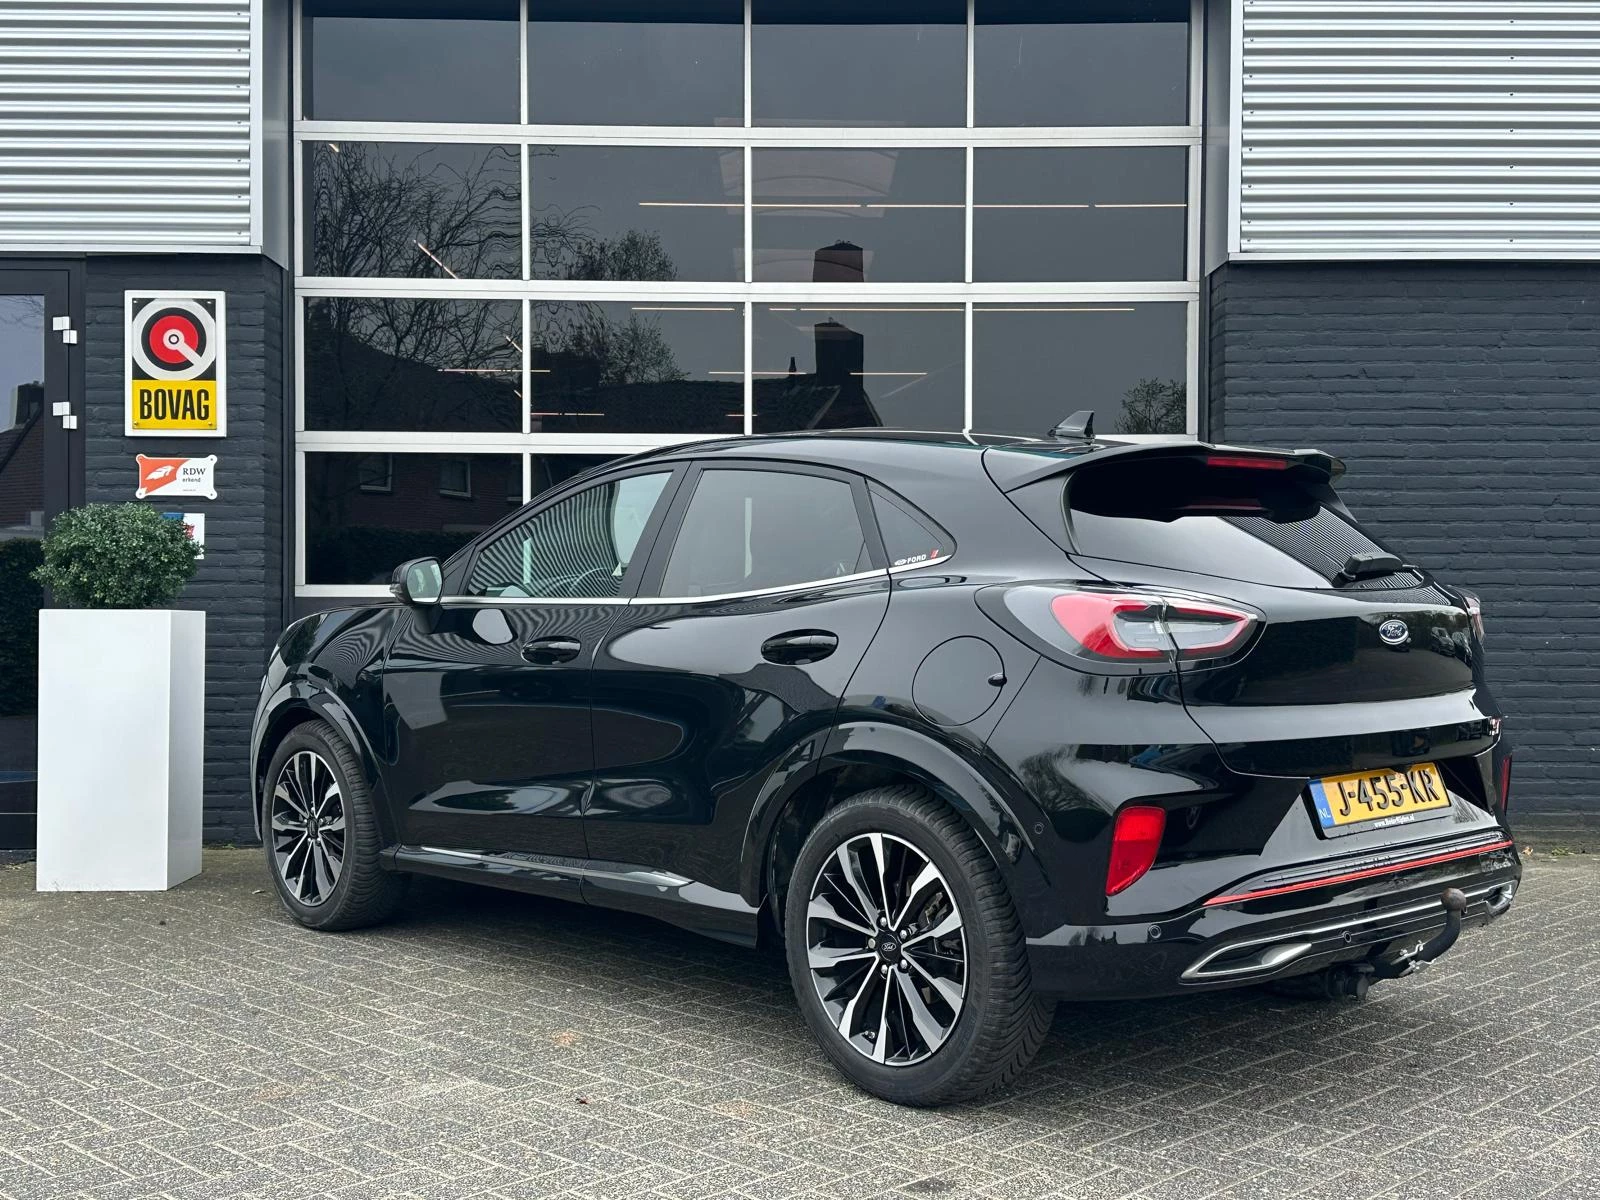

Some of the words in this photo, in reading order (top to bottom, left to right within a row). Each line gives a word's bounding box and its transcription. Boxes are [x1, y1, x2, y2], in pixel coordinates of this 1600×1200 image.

[139, 388, 210, 420] BOVAG
[182, 467, 206, 475] RDW
[907, 554, 927, 563] FORD
[1337, 769, 1440, 816] J-455-KR
[1318, 807, 1331, 818] NL
